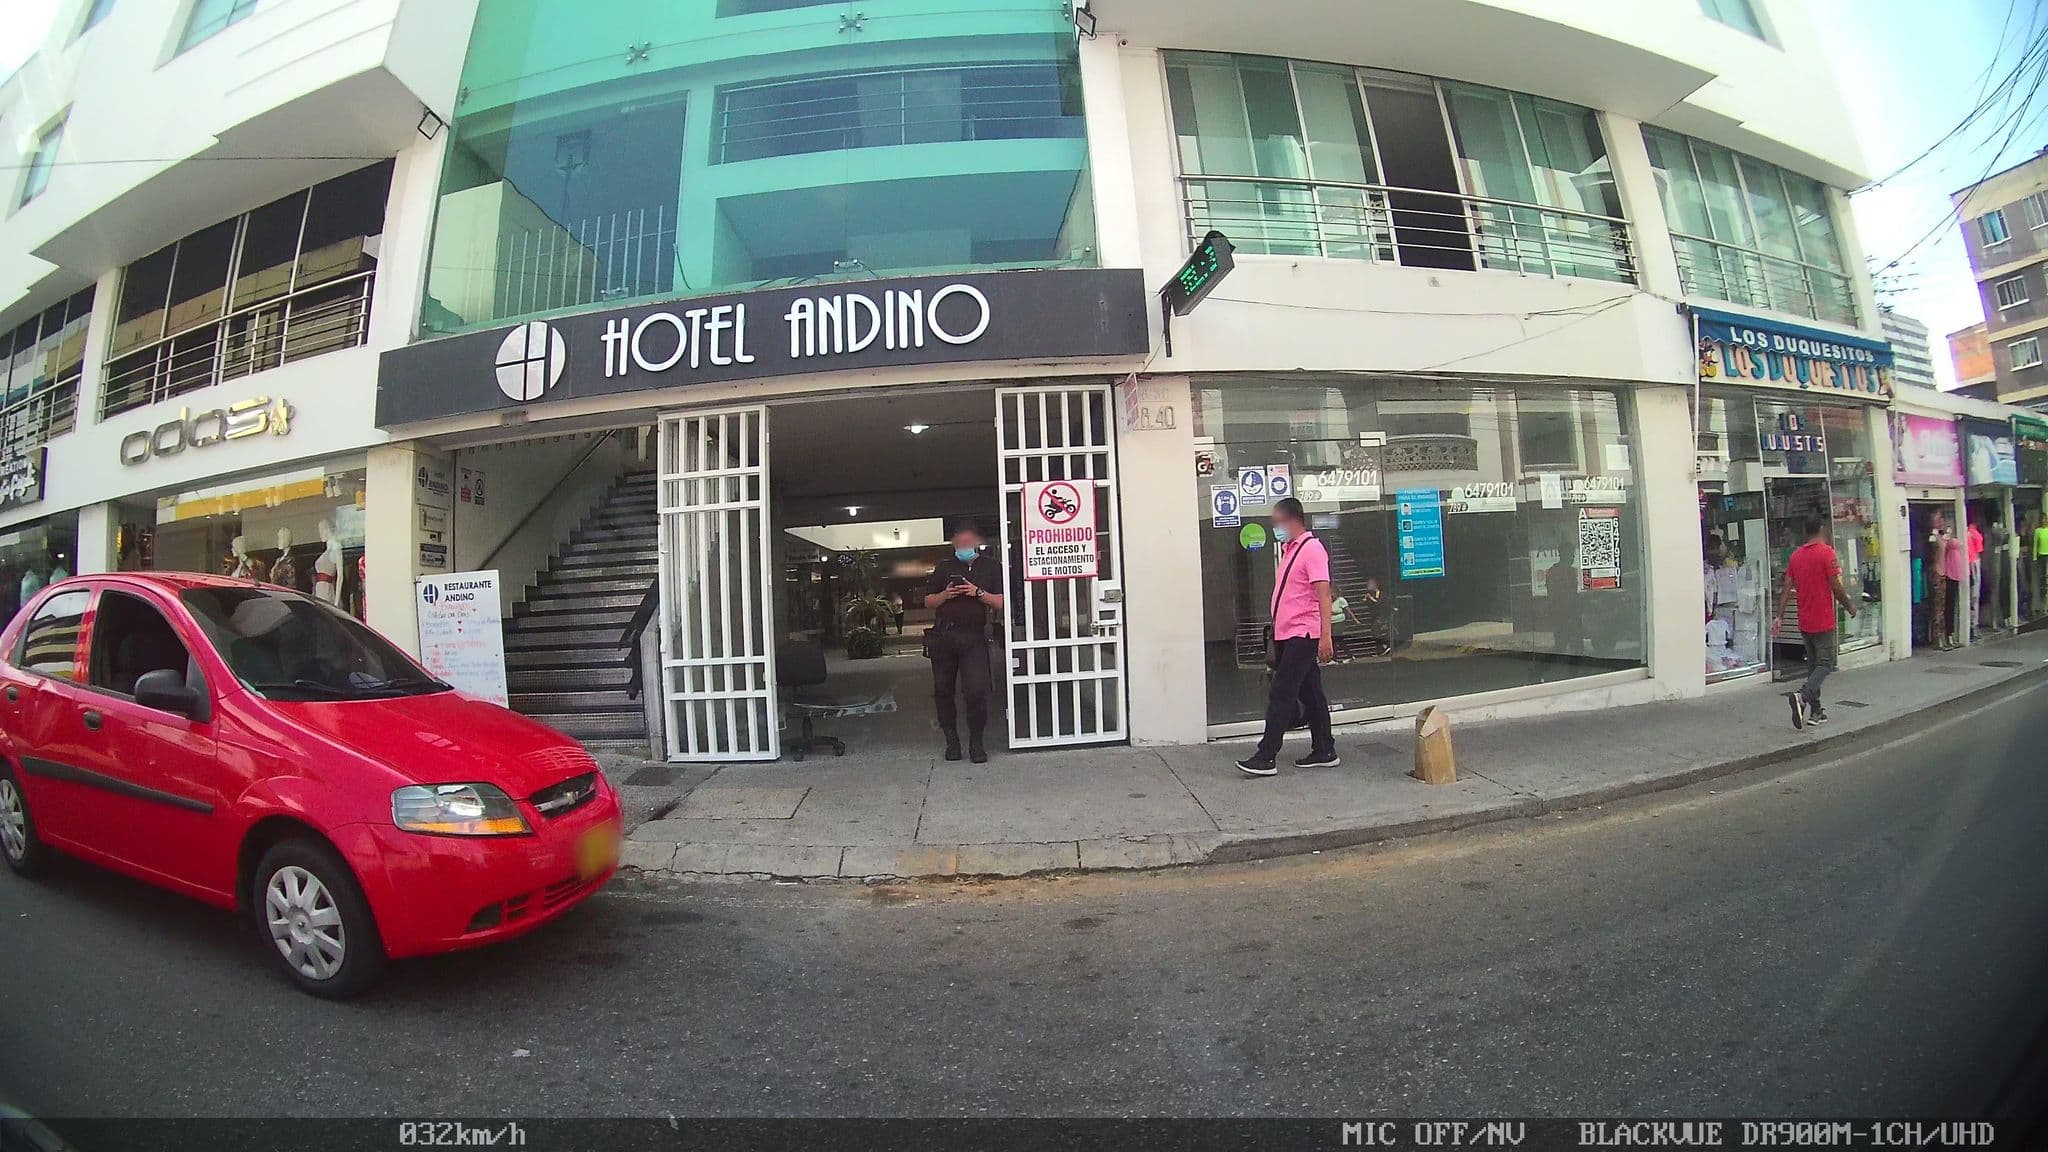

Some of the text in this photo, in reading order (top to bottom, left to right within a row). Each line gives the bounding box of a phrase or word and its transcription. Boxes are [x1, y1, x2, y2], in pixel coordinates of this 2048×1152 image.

[600, 283, 991, 378] HOTEL ANDINO
[1729, 326, 1874, 362] LOS DUQUESITOS
[1722, 346, 1765, 380] LOS
[1318, 469, 1377, 486] 6479101
[1464, 482, 1514, 498] 6479101
[1028, 526, 1092, 545] PROHIBIDO
[1035, 543, 1087, 556] EL ACCESO Y
[1029, 554, 1094, 567] ESTACIONAMIENTO
[1041, 565, 1083, 576] DE MOTOS
[444, 580, 493, 591] RESTAURANTE
[445, 593, 475, 602] ANDINO
